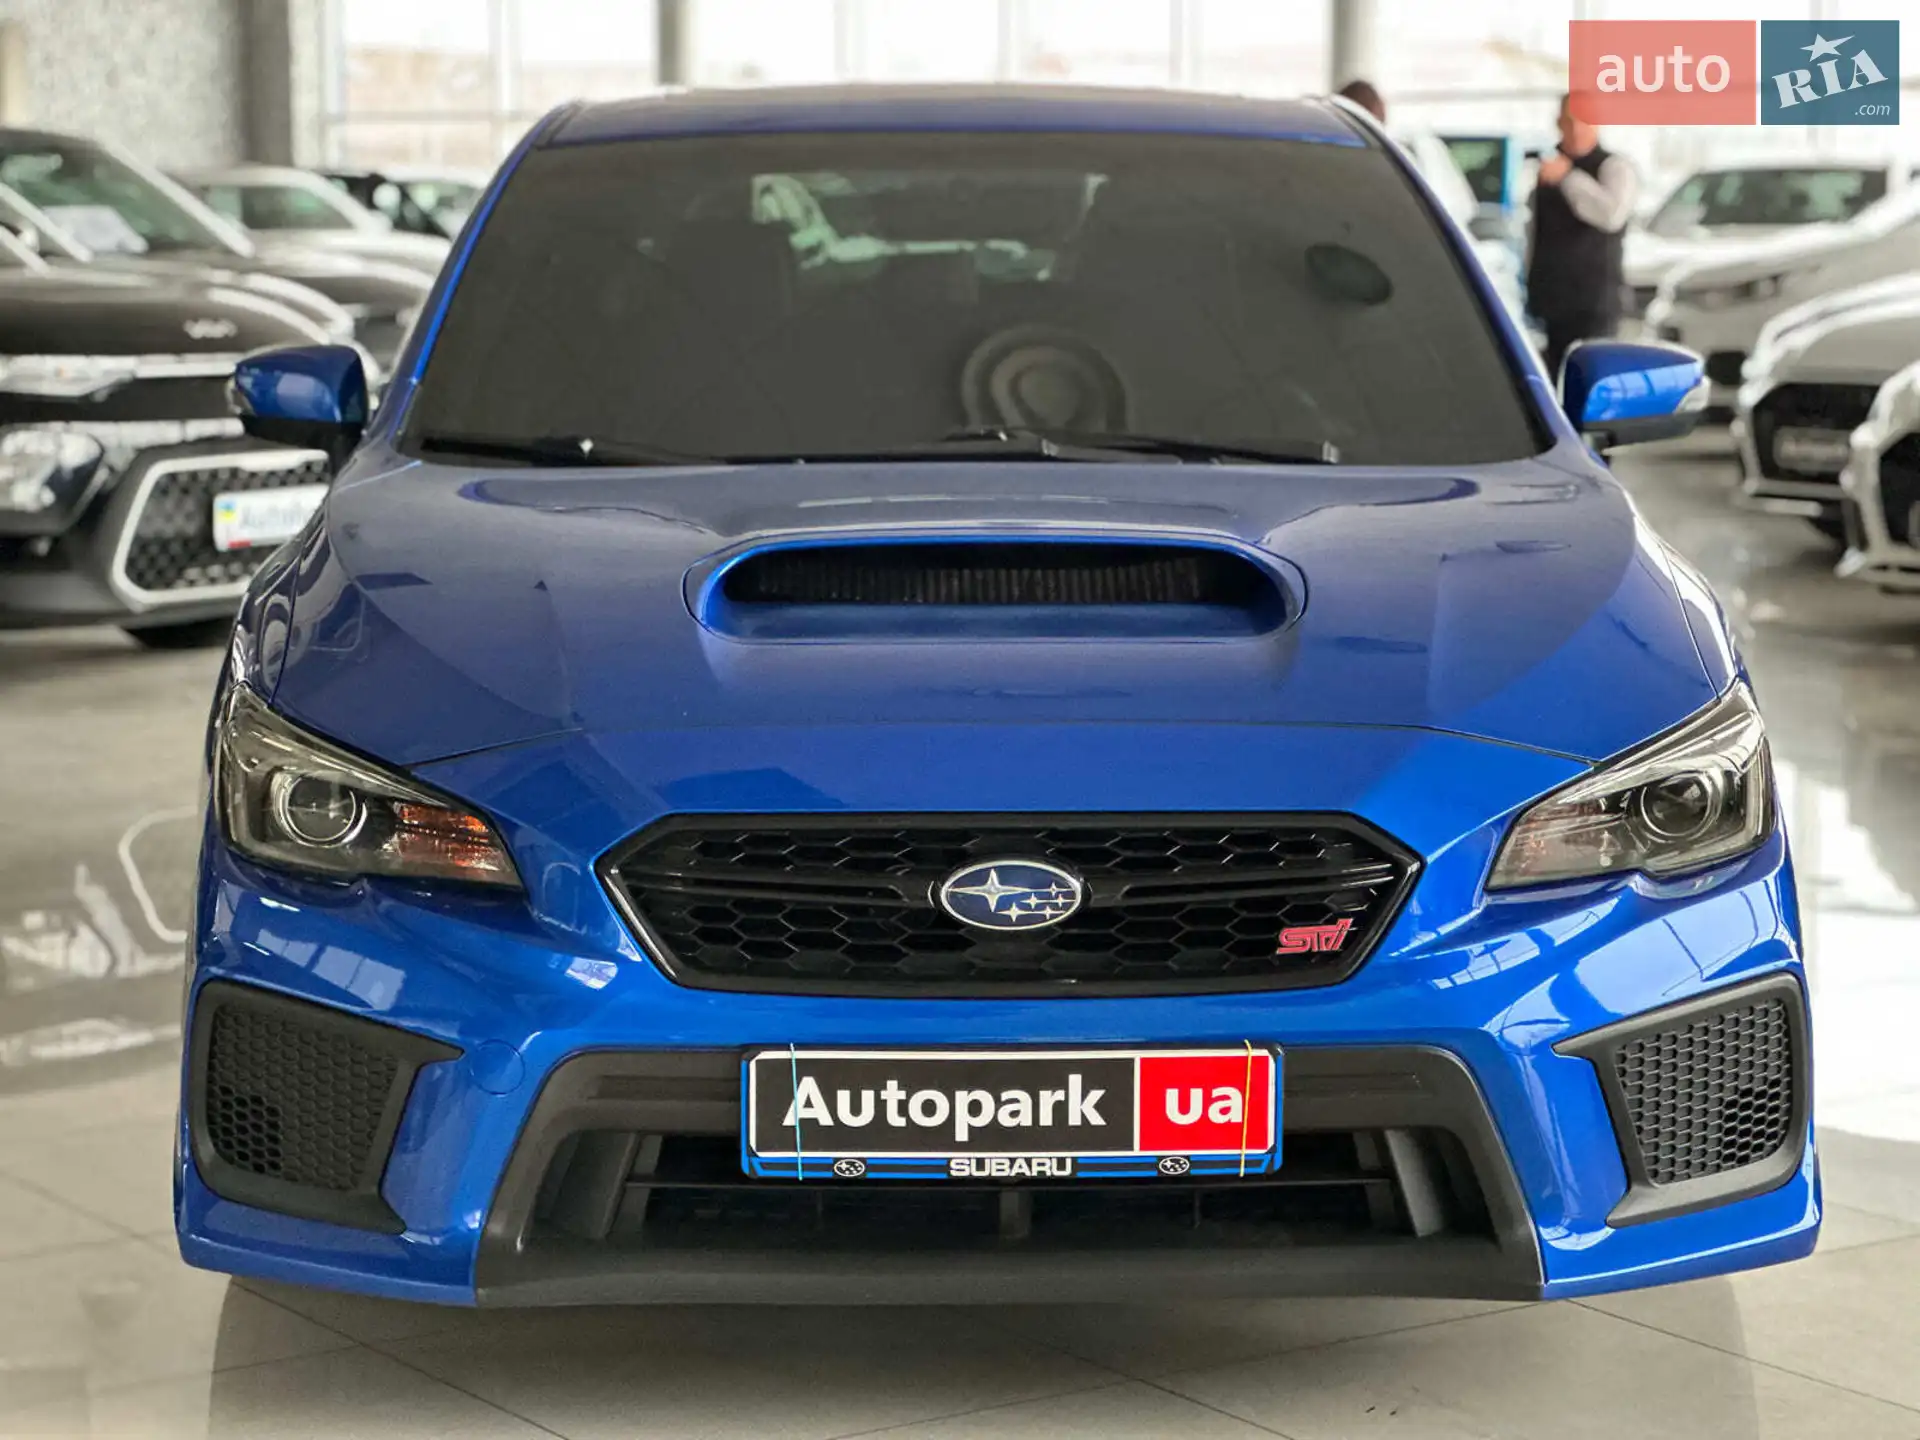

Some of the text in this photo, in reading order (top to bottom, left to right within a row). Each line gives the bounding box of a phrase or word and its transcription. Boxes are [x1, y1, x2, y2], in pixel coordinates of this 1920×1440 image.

[781, 1073, 1243, 1142] Autopark ua
[949, 1157, 1072, 1177] SUBARU
